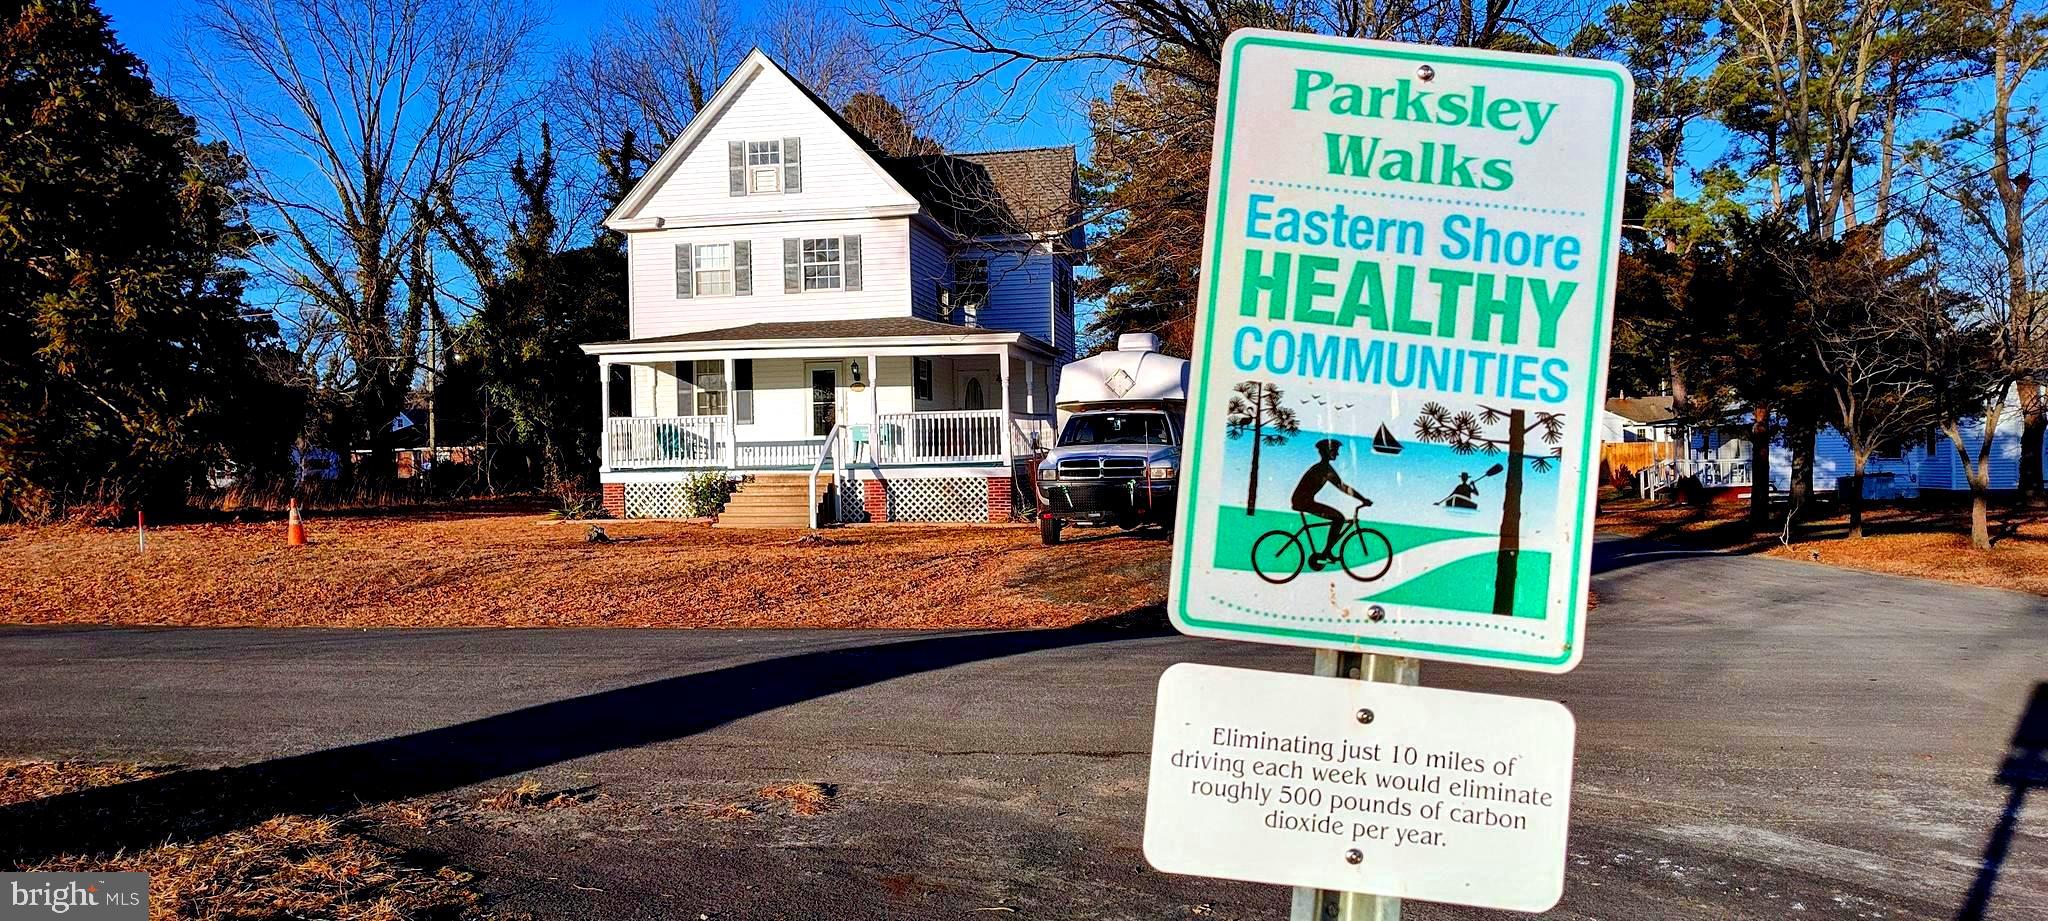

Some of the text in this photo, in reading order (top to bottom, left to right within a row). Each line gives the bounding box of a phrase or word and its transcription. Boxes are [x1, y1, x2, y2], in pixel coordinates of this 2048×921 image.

[1291, 69, 1559, 145] Parksley
[1323, 132, 1514, 191] Walks
[1246, 194, 1581, 270] Eastern Shore
[1239, 250, 1579, 348] HEALTHY
[1233, 326, 1569, 403] COMMUNITIES
[1171, 750, 1552, 807] driving each week would eliminate
[1213, 727, 1517, 776] Eliminating just 10 miles of
[1191, 777, 1527, 830] roughly 500 pounds of carbon
[1264, 810, 1447, 847] dioxide per year.
